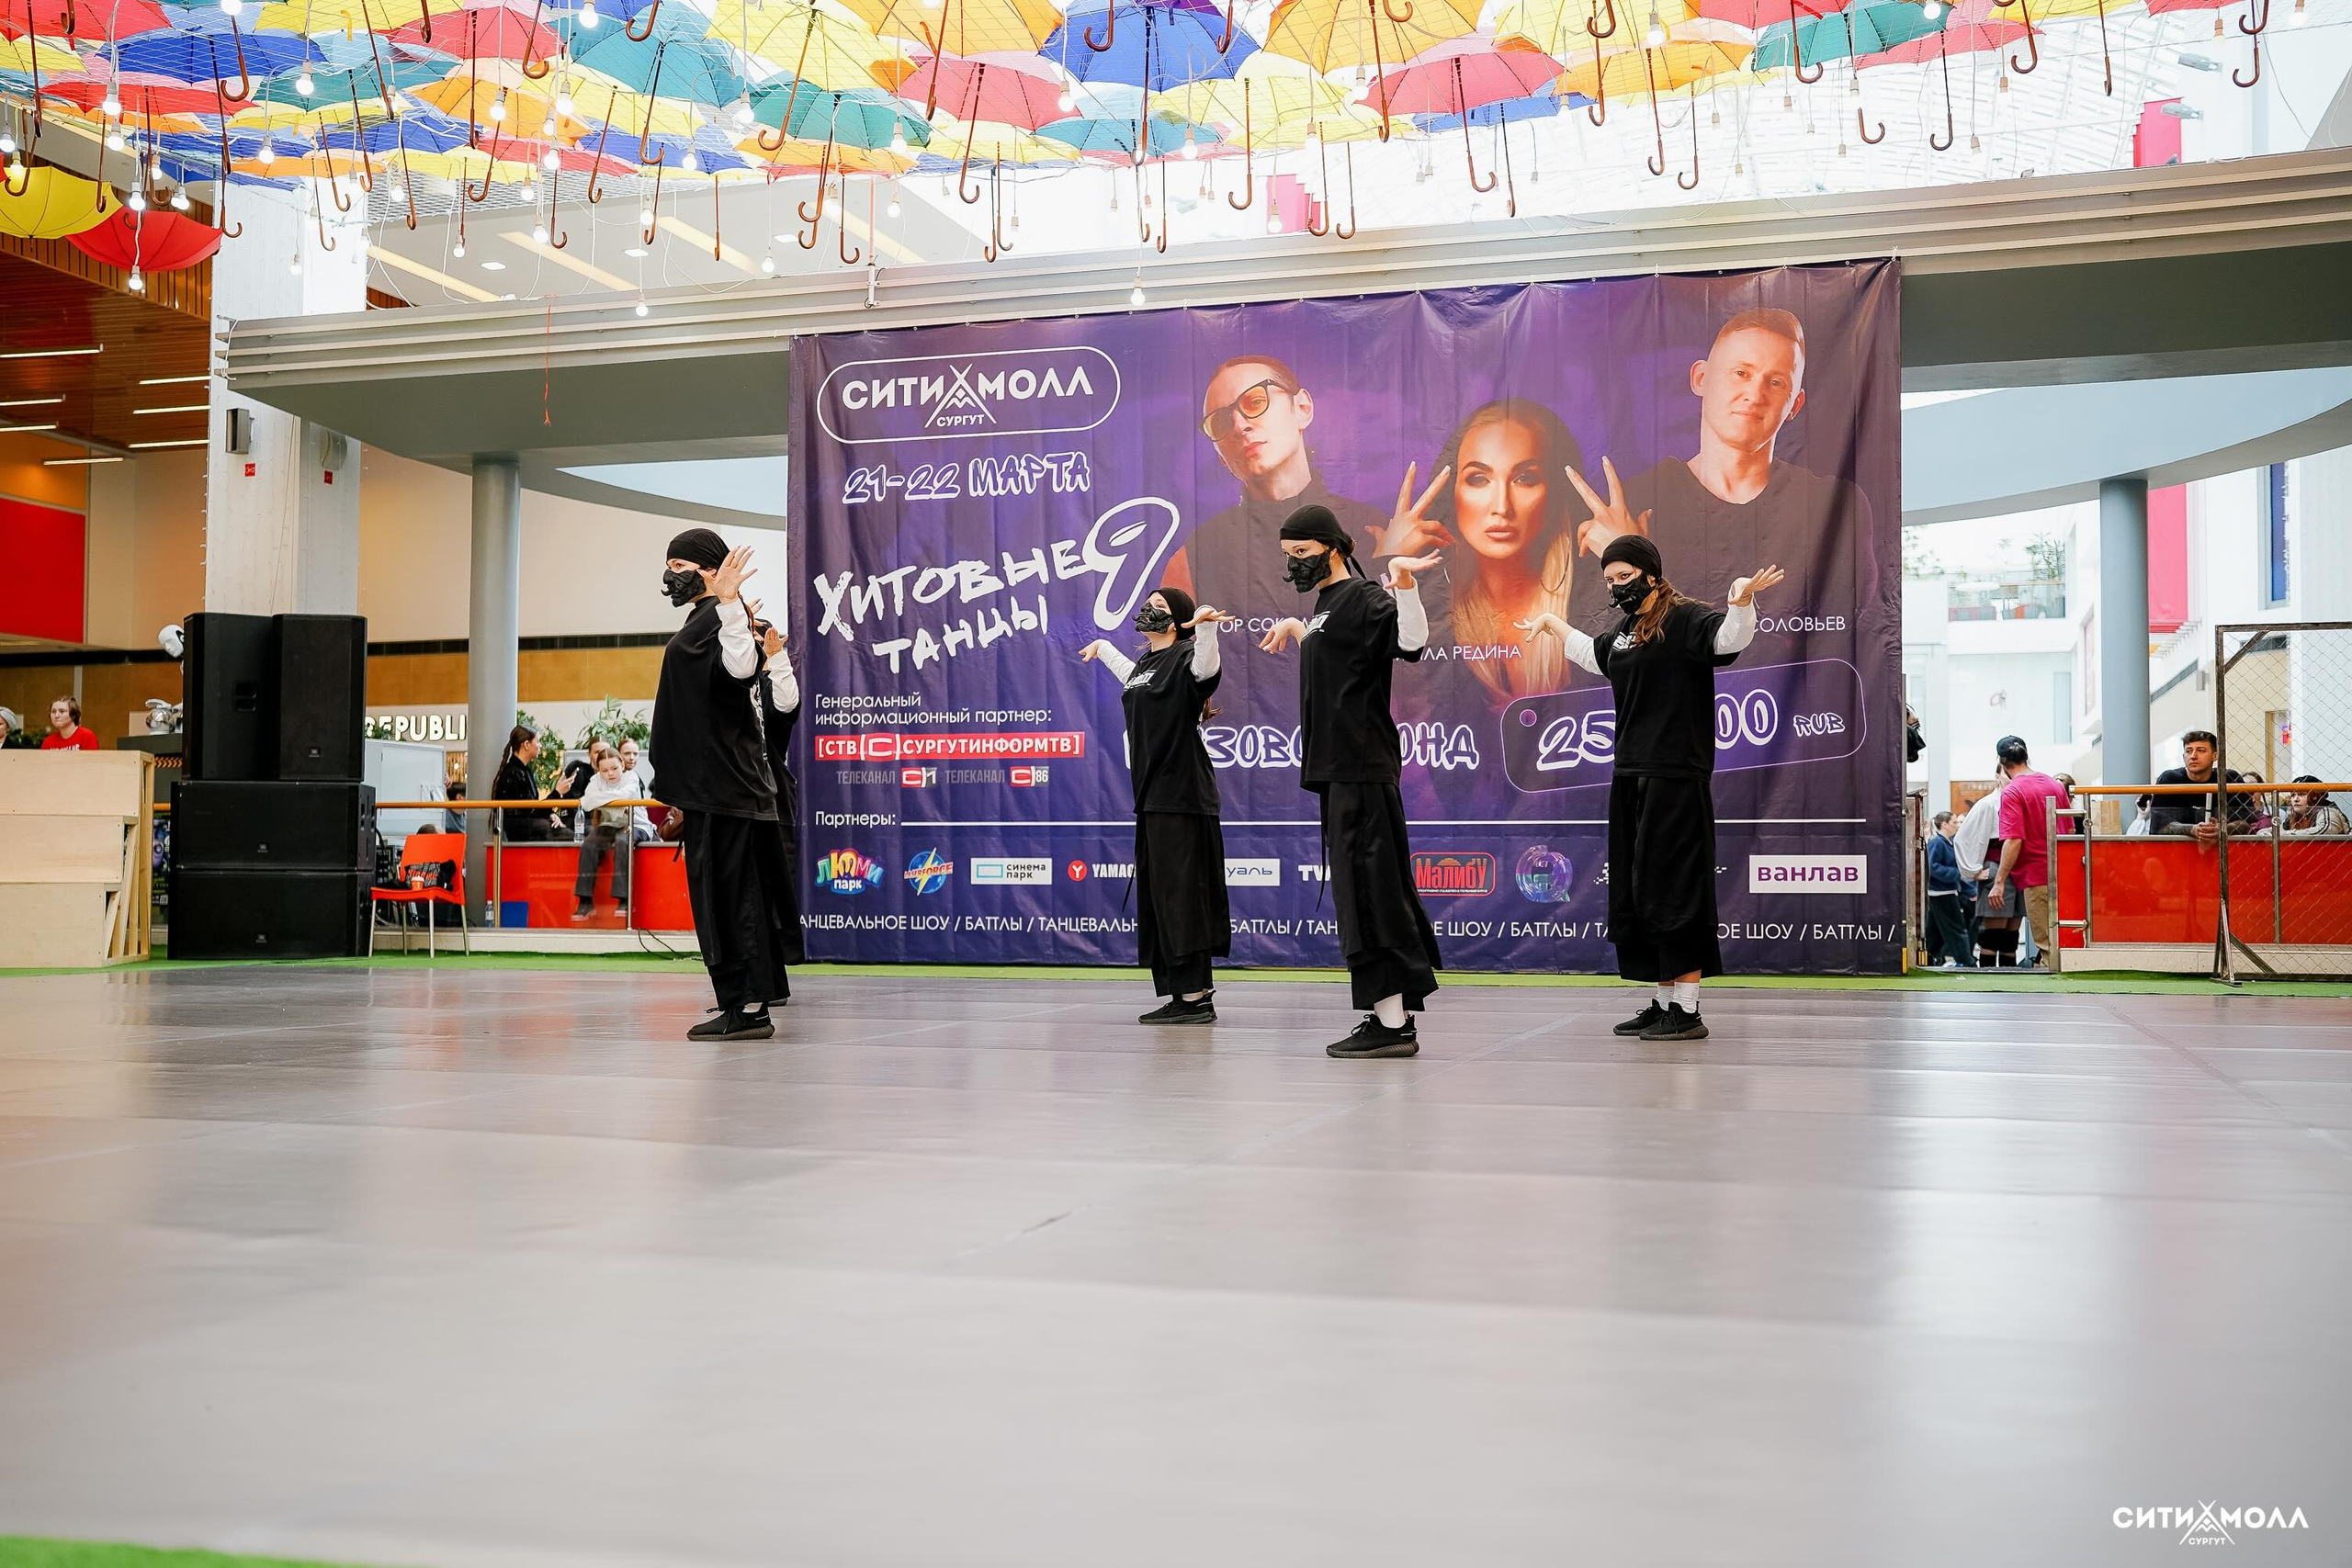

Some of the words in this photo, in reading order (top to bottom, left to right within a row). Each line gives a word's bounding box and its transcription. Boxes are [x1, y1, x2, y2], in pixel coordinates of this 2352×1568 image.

[842, 373, 944, 410] СИТИ
[978, 366, 1093, 402] МОЛЛ
[937, 414, 984, 427] СУРГУТ
[842, 464, 961, 503] 21-22
[969, 451, 1091, 497] МАРТА
[814, 540, 1088, 641] ХИТОВЫЕ
[873, 594, 1047, 673] ТАНЦЫ
[1453, 645, 1521, 660] РЕДИНА
[816, 692, 921, 710] Генеральный
[816, 707, 969, 728] информационный
[975, 708, 1052, 726] партнер:
[365, 715, 466, 741] REPUBLI
[1537, 709, 1615, 771] 25
[1792, 712, 1845, 737] RUB
[836, 771, 895, 784] ТЕЛЕКАНАЛ
[944, 769, 1005, 784] ТЕЛЕКАНАЛ
[815, 811, 896, 828] Партнеры:
[1227, 867, 1272, 877] уаль
[1757, 866, 1860, 882] ванлав
[834, 879, 862, 891] парк
[799, 915, 907, 930] АНЦЕВАЛЬНОЕ
[910, 916, 950, 930] ШОУ
[966, 917, 1023, 931] БАТТЛЫ
[1448, 921, 1493, 937] ШОУ
[1510, 922, 1577, 938] БАТТЛЫ
[1747, 923, 1793, 940] ШОУ
[1814, 924, 1882, 940] БАТТЛЫ
